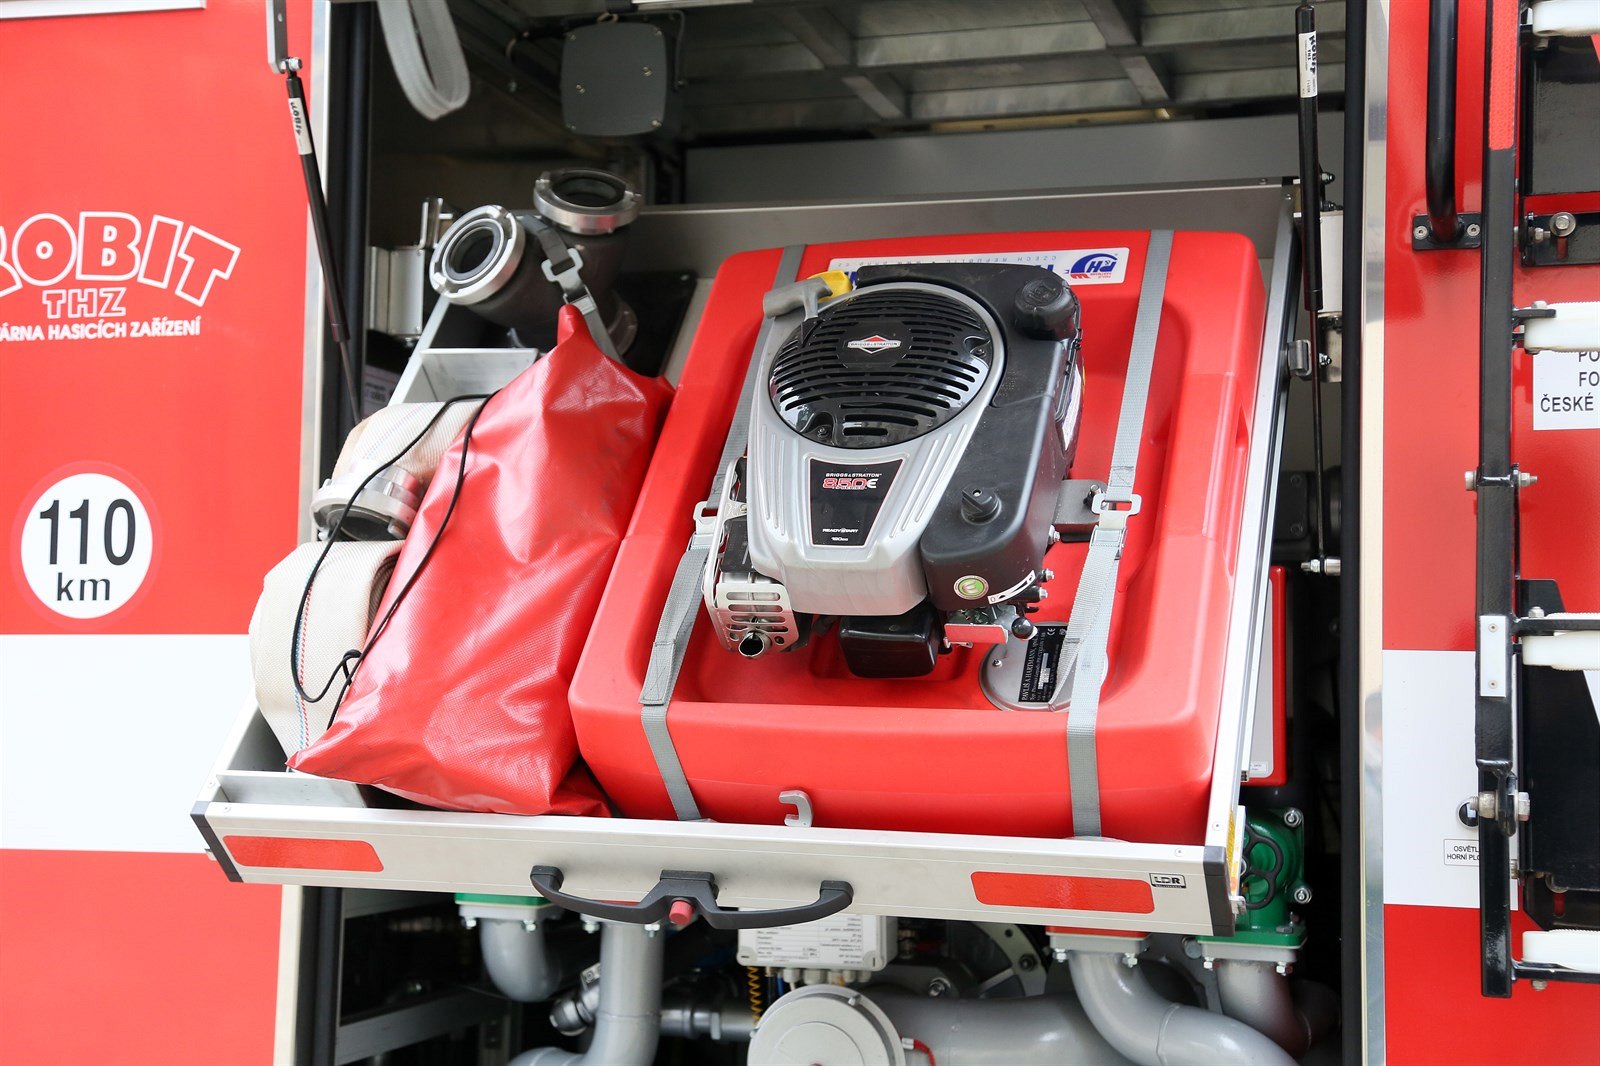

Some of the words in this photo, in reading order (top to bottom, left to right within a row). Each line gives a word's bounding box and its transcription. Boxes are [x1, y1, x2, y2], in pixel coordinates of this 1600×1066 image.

[42, 287, 127, 319] THZ
[0, 322, 45, 342] ÁRNA
[48, 319, 127, 340] HASICÍCH
[130, 315, 201, 338] ZAŘÍZENÍ
[1578, 371, 1600, 387] FO
[1540, 392, 1595, 413] ČESKÉ
[39, 498, 136, 566] 110
[56, 572, 111, 601] km
